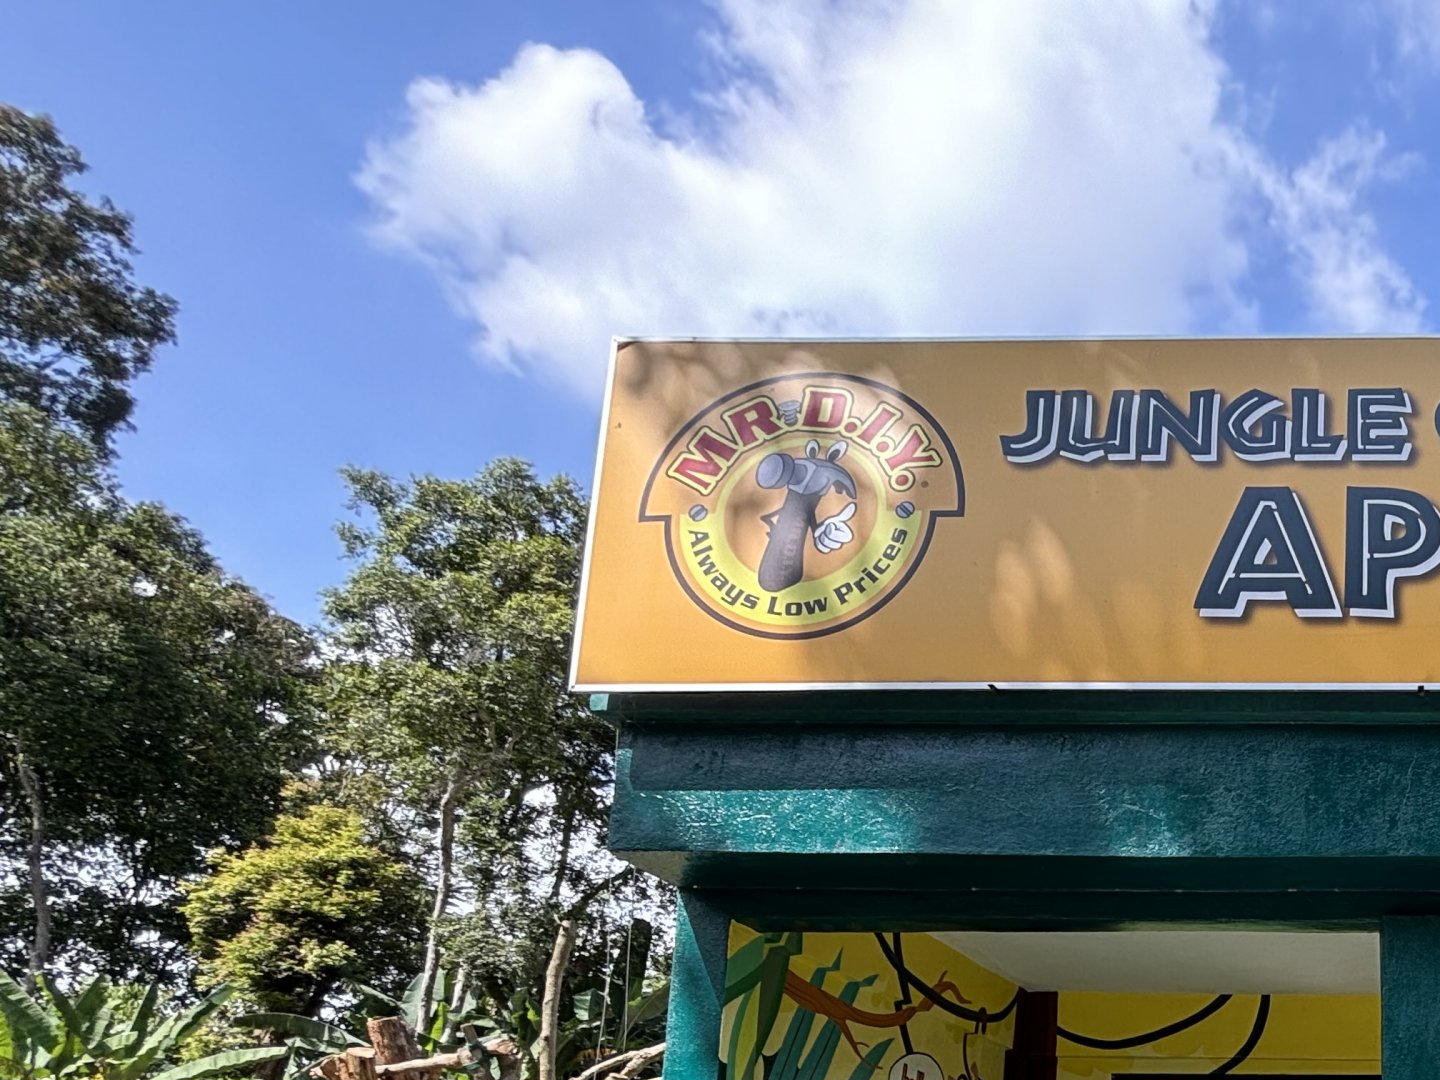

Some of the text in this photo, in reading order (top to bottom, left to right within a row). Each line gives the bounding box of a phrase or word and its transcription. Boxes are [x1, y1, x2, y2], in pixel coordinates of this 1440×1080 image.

[999, 387, 1413, 462] JUNGLE
[688, 529, 760, 608] Always
[767, 596, 828, 617] Low
[833, 527, 908, 605] Prices
